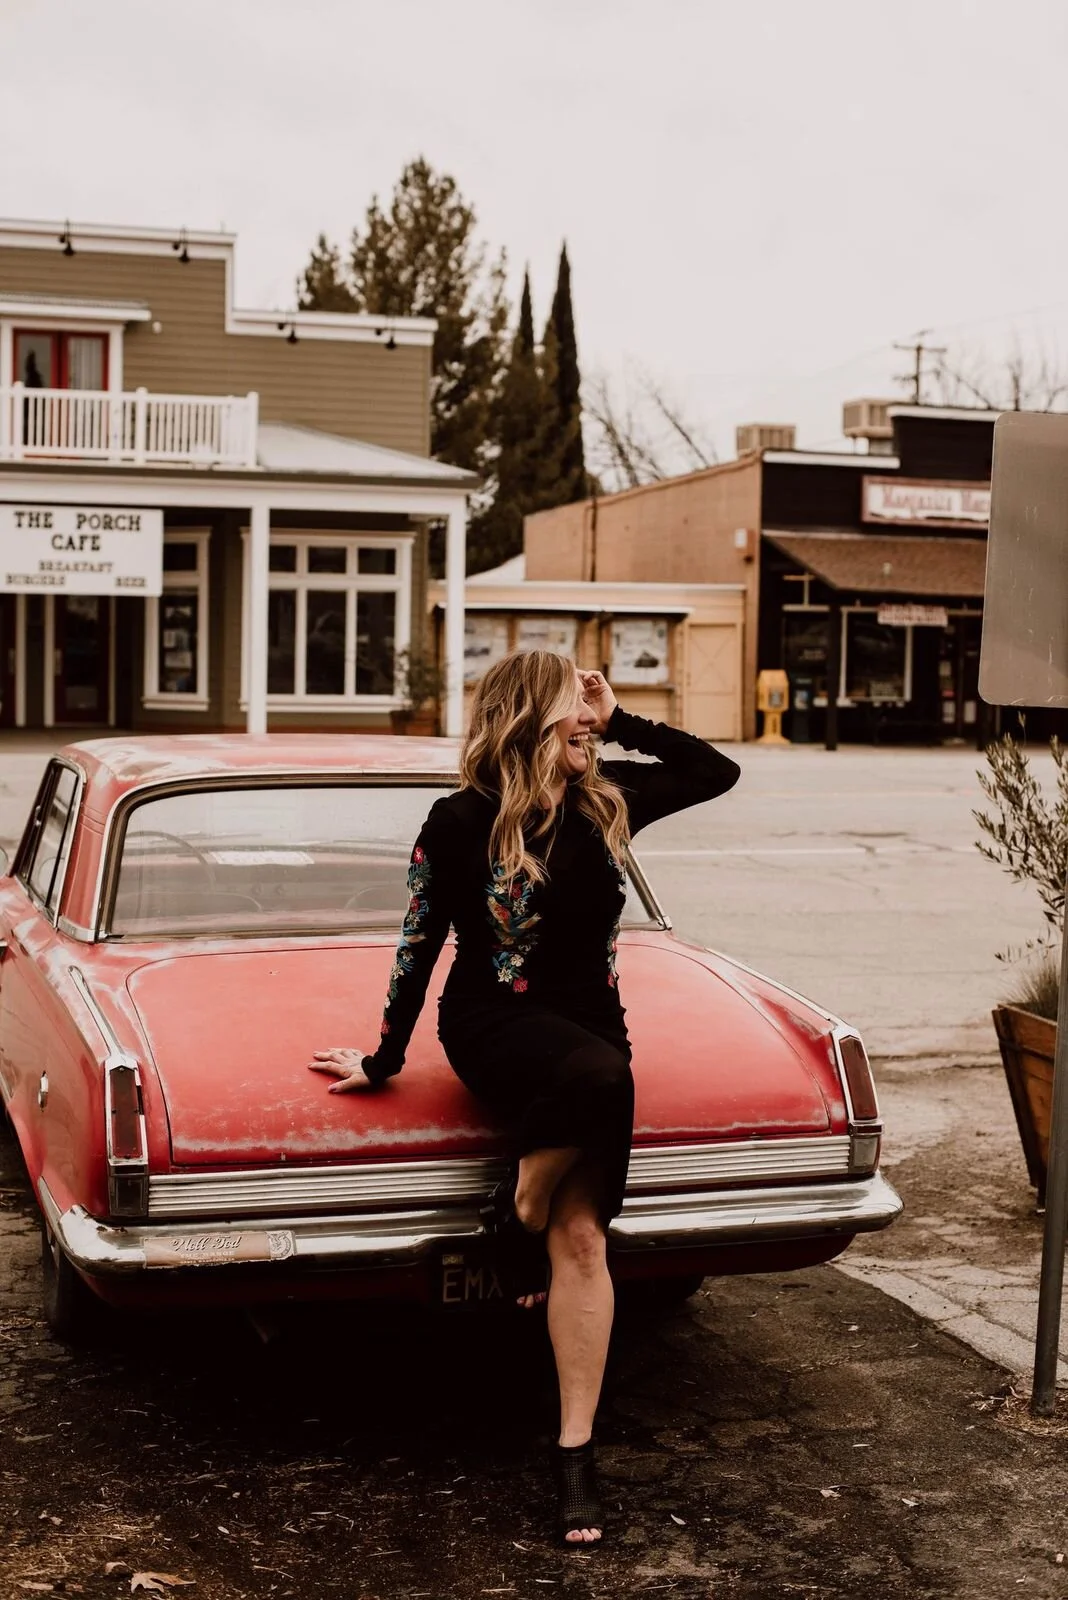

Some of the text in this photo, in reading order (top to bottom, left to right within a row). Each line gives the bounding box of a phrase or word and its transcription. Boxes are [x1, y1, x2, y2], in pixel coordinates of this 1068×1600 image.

[13, 511, 141, 531] THE PORCH
[51, 534, 101, 551] CAFE
